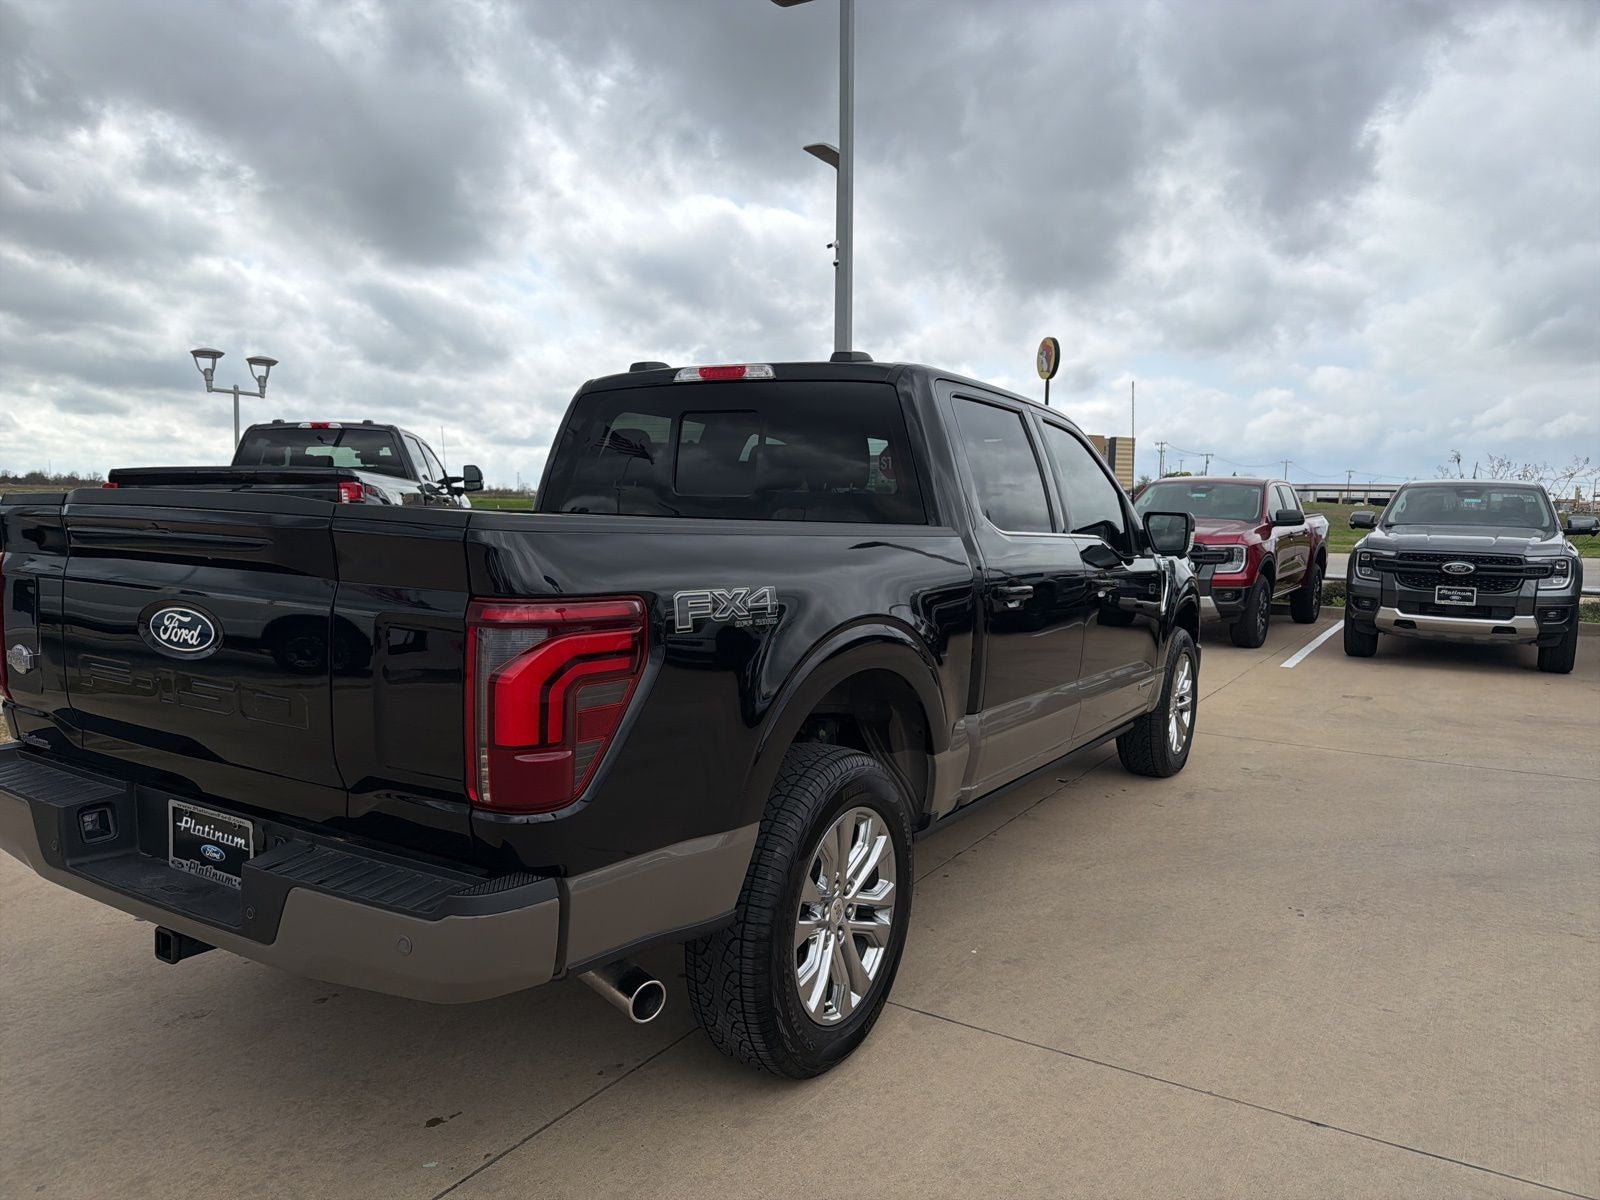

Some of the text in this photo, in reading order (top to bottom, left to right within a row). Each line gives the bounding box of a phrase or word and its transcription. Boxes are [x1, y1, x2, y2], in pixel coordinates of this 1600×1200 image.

[673, 586, 778, 633] FX4
[1439, 589, 1472, 597] Platinum
[159, 612, 202, 645] Ford
[79, 653, 309, 730] F-150
[176, 816, 249, 851] Platinum
[205, 848, 221, 860] Ford
[188, 860, 237, 887] Platinum
